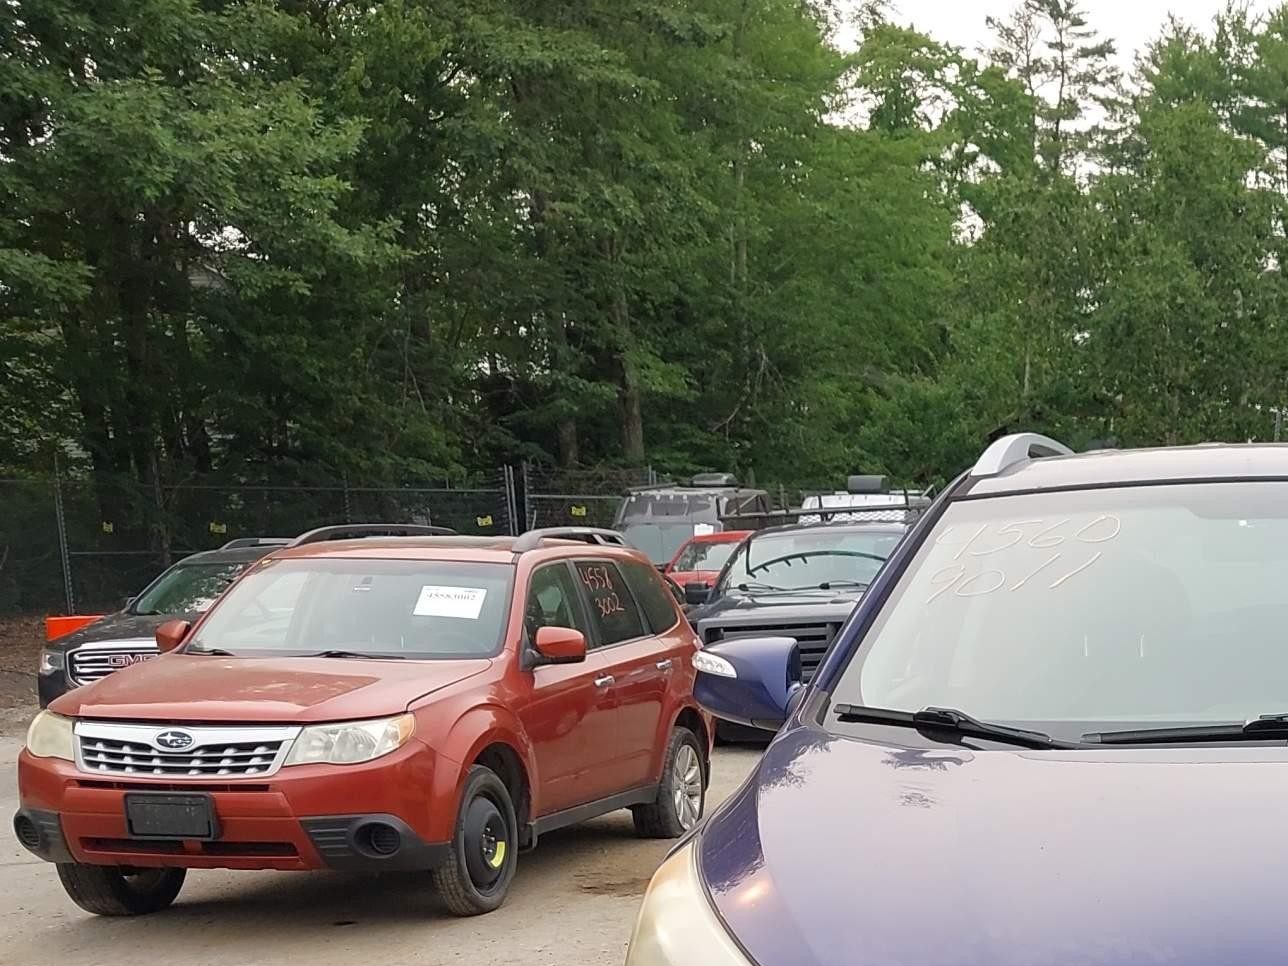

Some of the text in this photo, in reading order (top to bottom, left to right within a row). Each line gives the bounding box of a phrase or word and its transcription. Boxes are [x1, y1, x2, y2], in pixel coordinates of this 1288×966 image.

[936, 514, 1121, 560] 4560
[578, 566, 613, 593] 4558
[926, 551, 1102, 605] 9011
[595, 592, 625, 618] 3002
